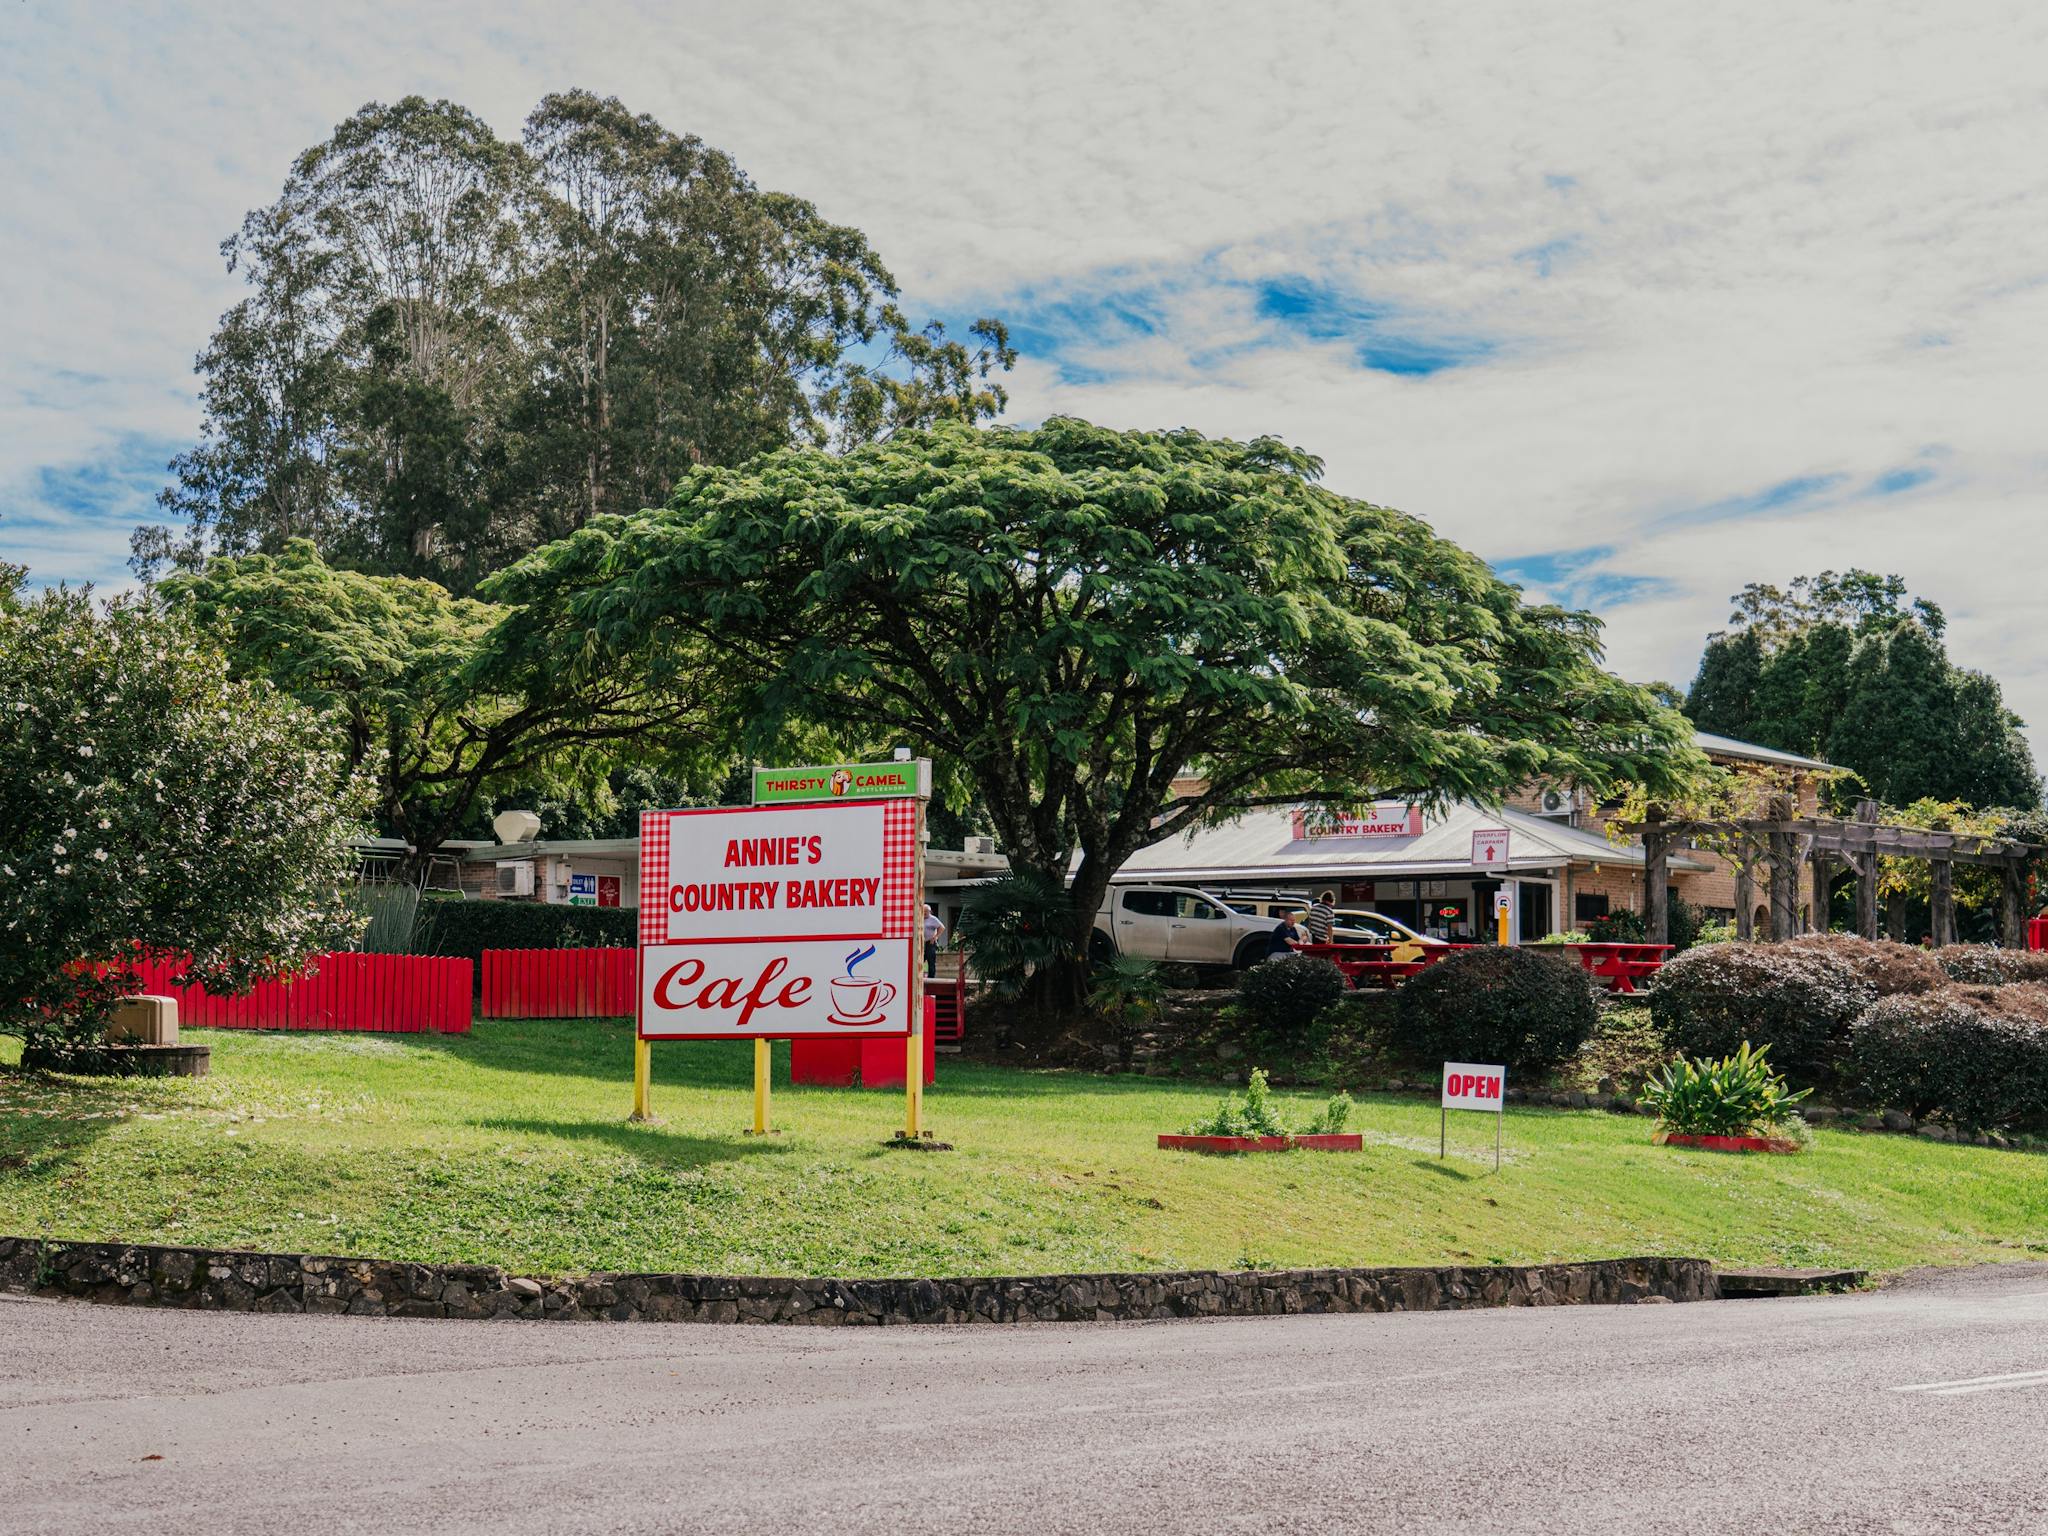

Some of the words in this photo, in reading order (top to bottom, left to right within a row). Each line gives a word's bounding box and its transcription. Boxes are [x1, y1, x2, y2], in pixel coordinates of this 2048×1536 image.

[766, 778, 825, 792] THIRSTY
[856, 774, 906, 787] CAMEL
[1309, 825, 1359, 836] COUNTRY
[1362, 823, 1404, 834] BAKERY
[724, 835, 822, 868] ANNIE'S
[669, 881, 779, 913] COUNTRY
[786, 877, 880, 909] BAKERY
[652, 957, 812, 1026] Cafe
[1447, 1073, 1500, 1099] OPEN
